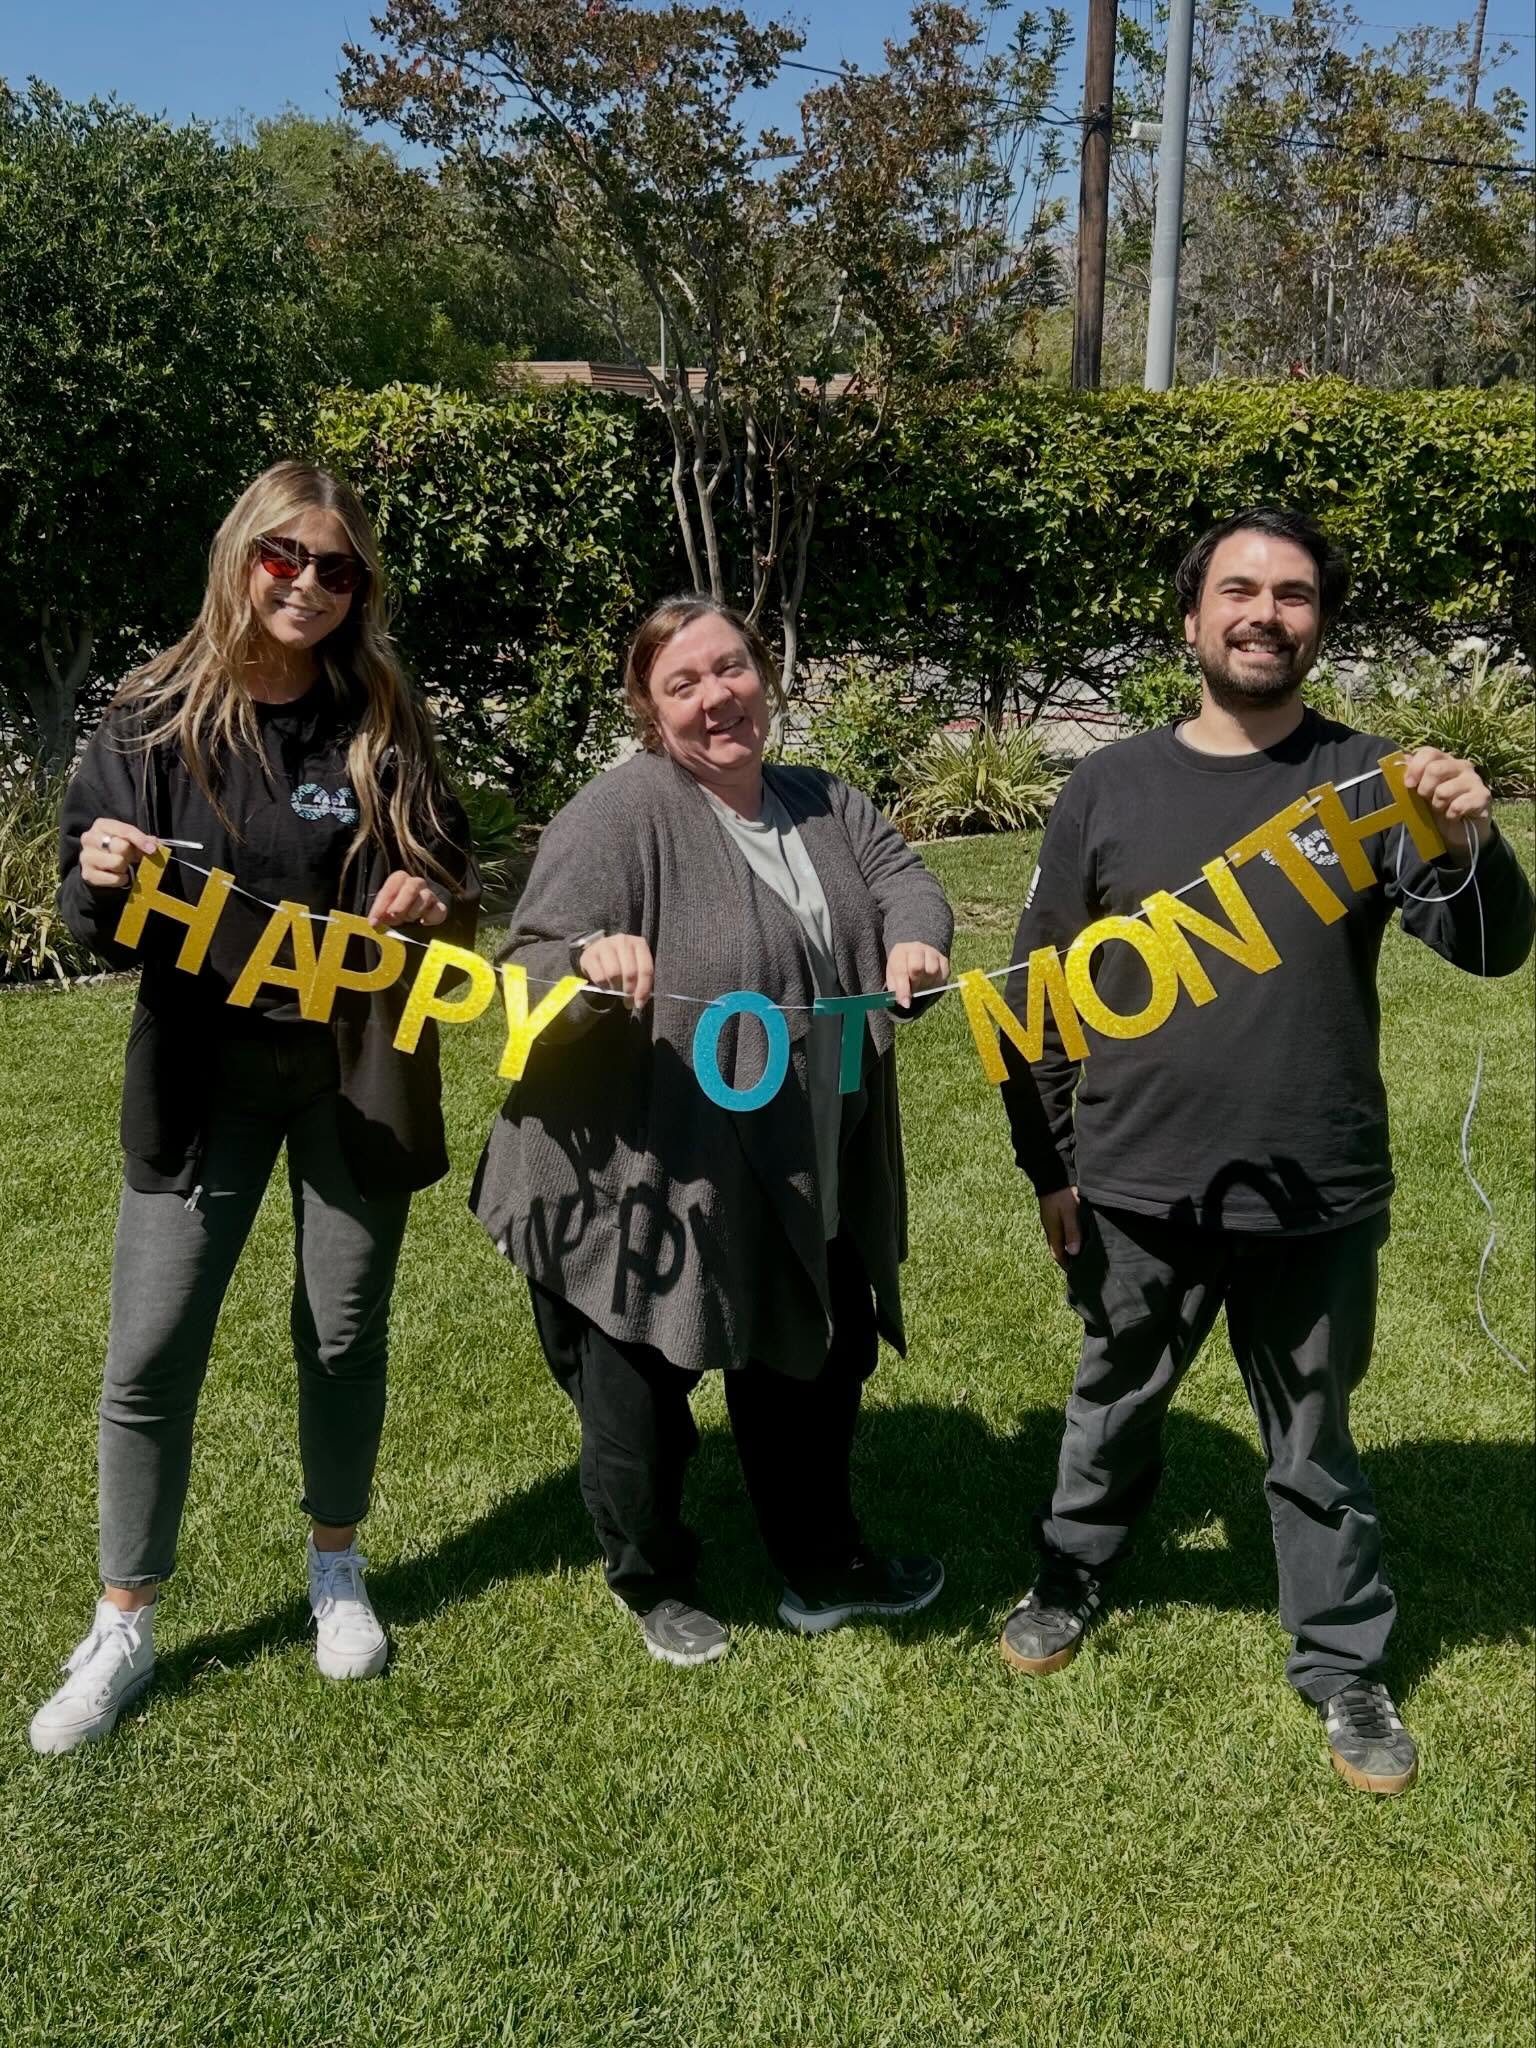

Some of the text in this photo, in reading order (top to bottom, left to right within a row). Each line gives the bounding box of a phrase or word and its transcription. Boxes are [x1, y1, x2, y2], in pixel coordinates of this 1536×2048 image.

[114, 751, 1446, 1112] HAPPY OT MONTH
